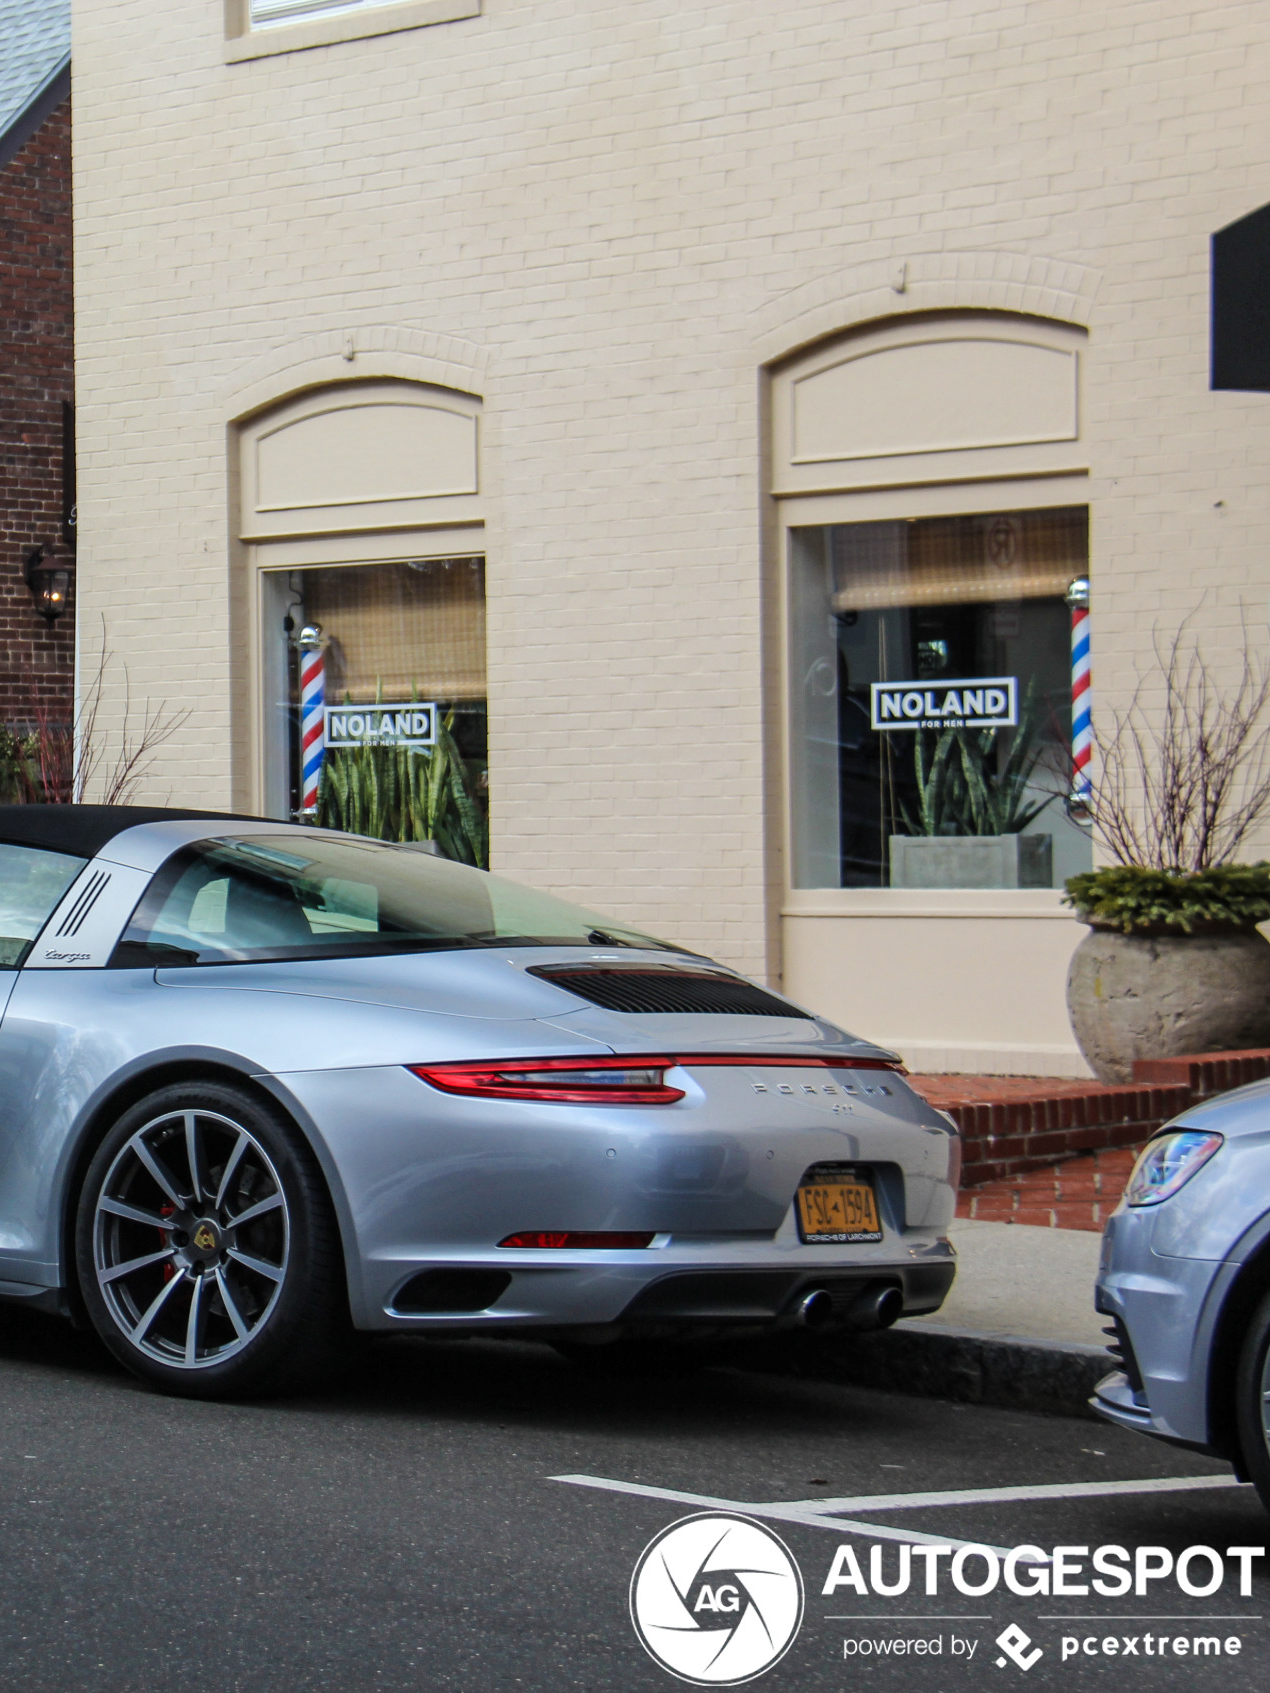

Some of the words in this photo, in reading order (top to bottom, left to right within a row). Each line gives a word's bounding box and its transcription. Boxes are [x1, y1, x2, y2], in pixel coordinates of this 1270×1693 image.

[880, 688, 1007, 719] NOLAND
[331, 713, 429, 738] NOLAND
[921, 720, 940, 728] FOR
[943, 719, 964, 728] MEN
[751, 1083, 893, 1096] PORSCHE
